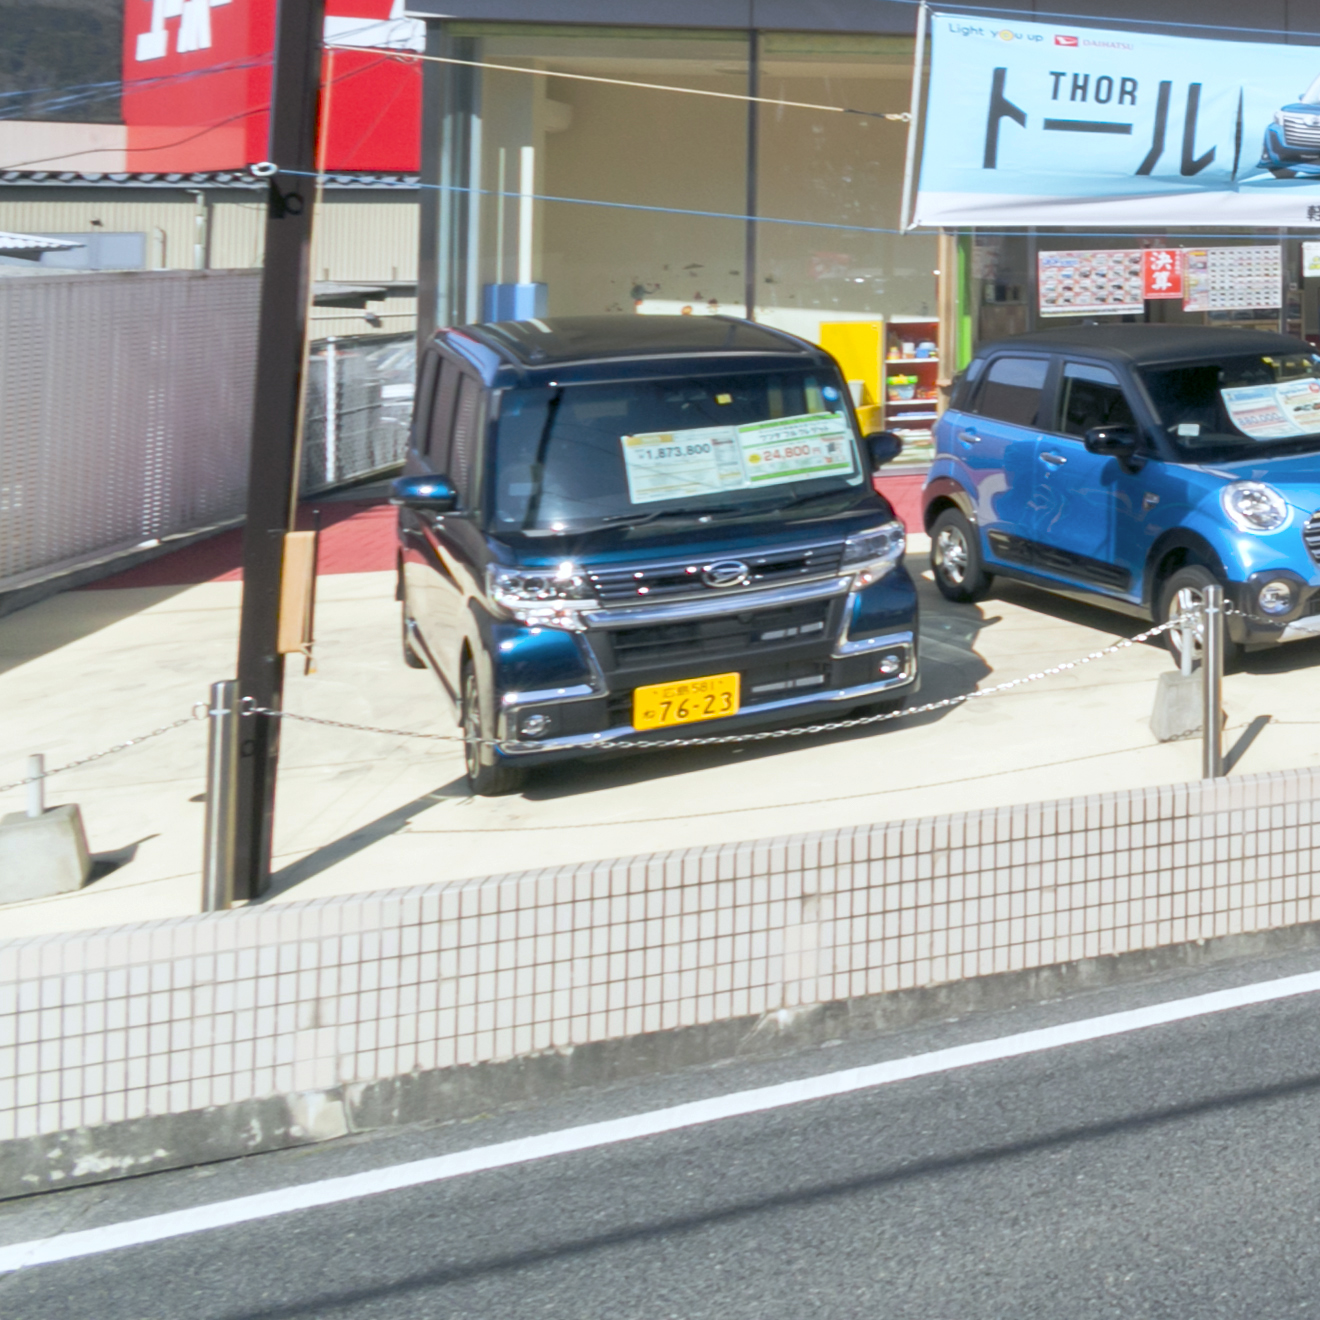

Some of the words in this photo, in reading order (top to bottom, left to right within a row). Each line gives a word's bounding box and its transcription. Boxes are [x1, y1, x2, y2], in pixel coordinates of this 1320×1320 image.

[948, 23, 984, 37] Light
[1027, 33, 1044, 43] up
[1082, 38, 1134, 51] DAIHATSU
[1049, 70, 1139, 106] THOR
[982, 66, 1218, 177] トール
[1150, 250, 1174, 292] 決算
[691, 681, 715, 694] 581
[659, 691, 733, 722] 76-23
